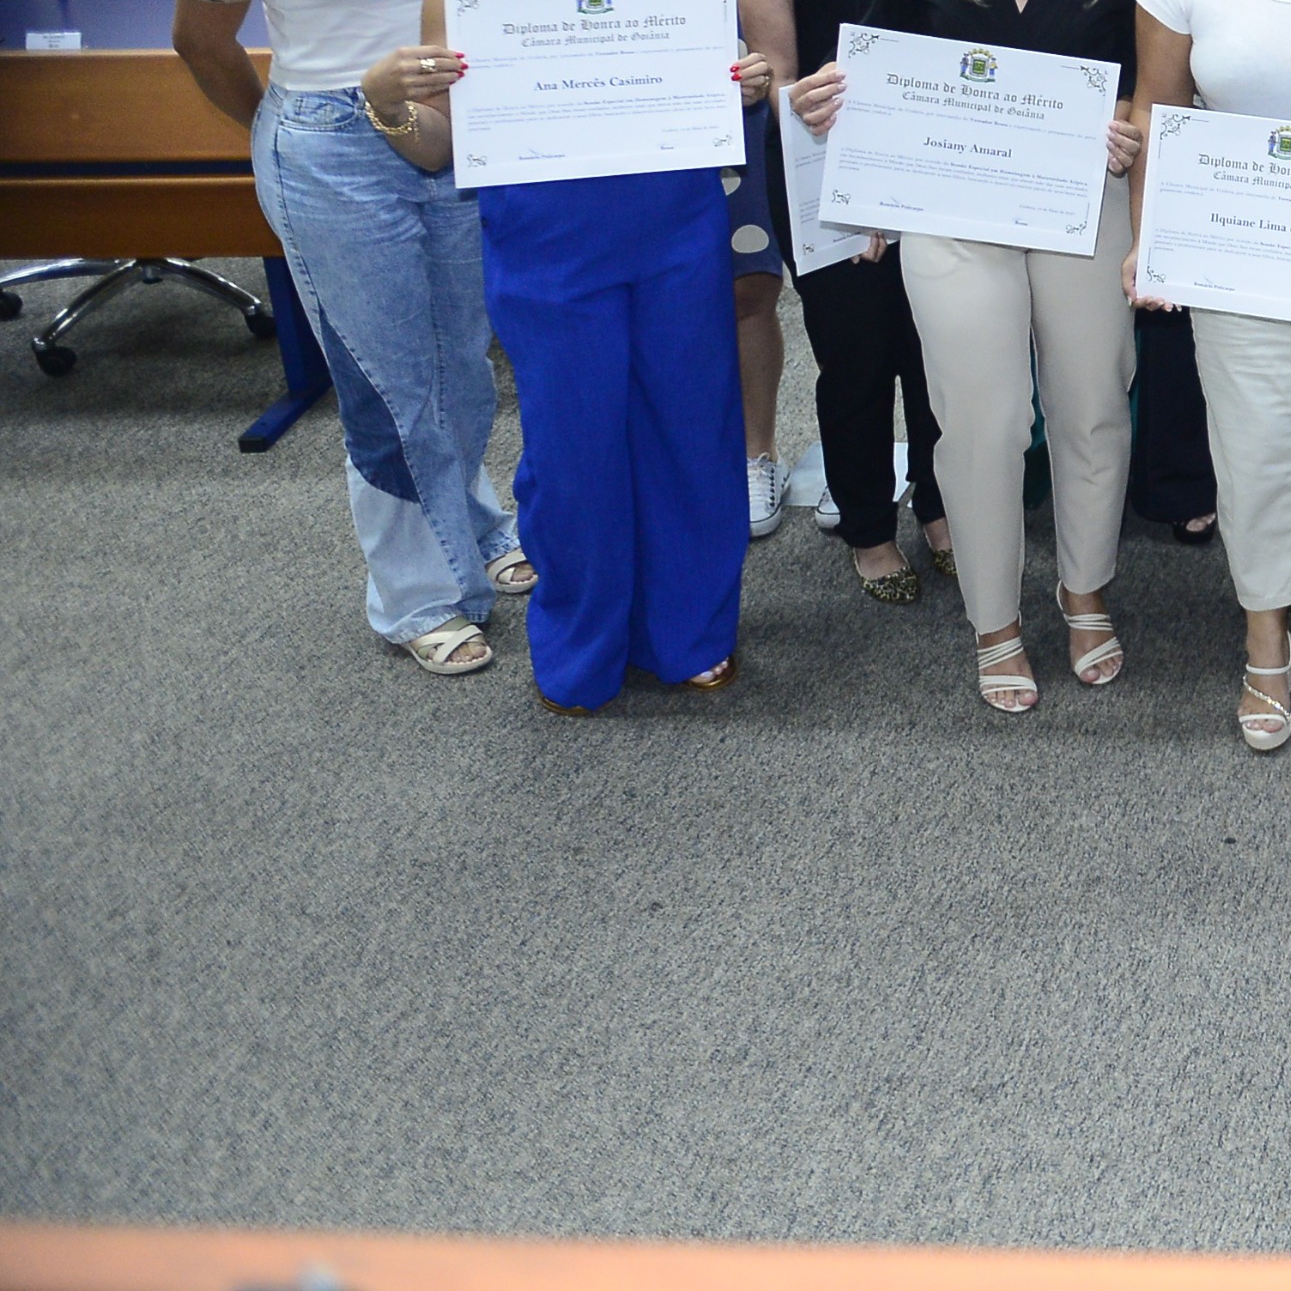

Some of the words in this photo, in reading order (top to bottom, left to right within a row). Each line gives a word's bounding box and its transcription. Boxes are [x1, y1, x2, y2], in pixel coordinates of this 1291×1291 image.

[502, 22, 558, 36] Diploma
[562, 20, 575, 32] de
[625, 19, 639, 28] ao
[643, 15, 686, 28] Mérito
[564, 33, 614, 47] Municipal
[618, 32, 628, 42] de
[534, 80, 558, 92] Ana
[562, 74, 606, 90] Mercês
[610, 74, 662, 88] Casimiro
[886, 73, 939, 92] Diploma
[943, 82, 956, 94] de
[961, 84, 1000, 100] Honra
[1004, 92, 1018, 102] ao
[1020, 93, 1064, 110] Mérito
[902, 91, 940, 106] Câmara
[943, 96, 992, 114] Municipal
[994, 104, 1004, 114] de
[924, 136, 966, 154] Josiany
[970, 143, 1012, 158] Amaral
[1199, 154, 1248, 171] Diploma
[1252, 162, 1264, 172] de
[1213, 170, 1248, 185] Câmara
[1210, 213, 1256, 230] Ilquiane
[1259, 220, 1286, 234] Lima
